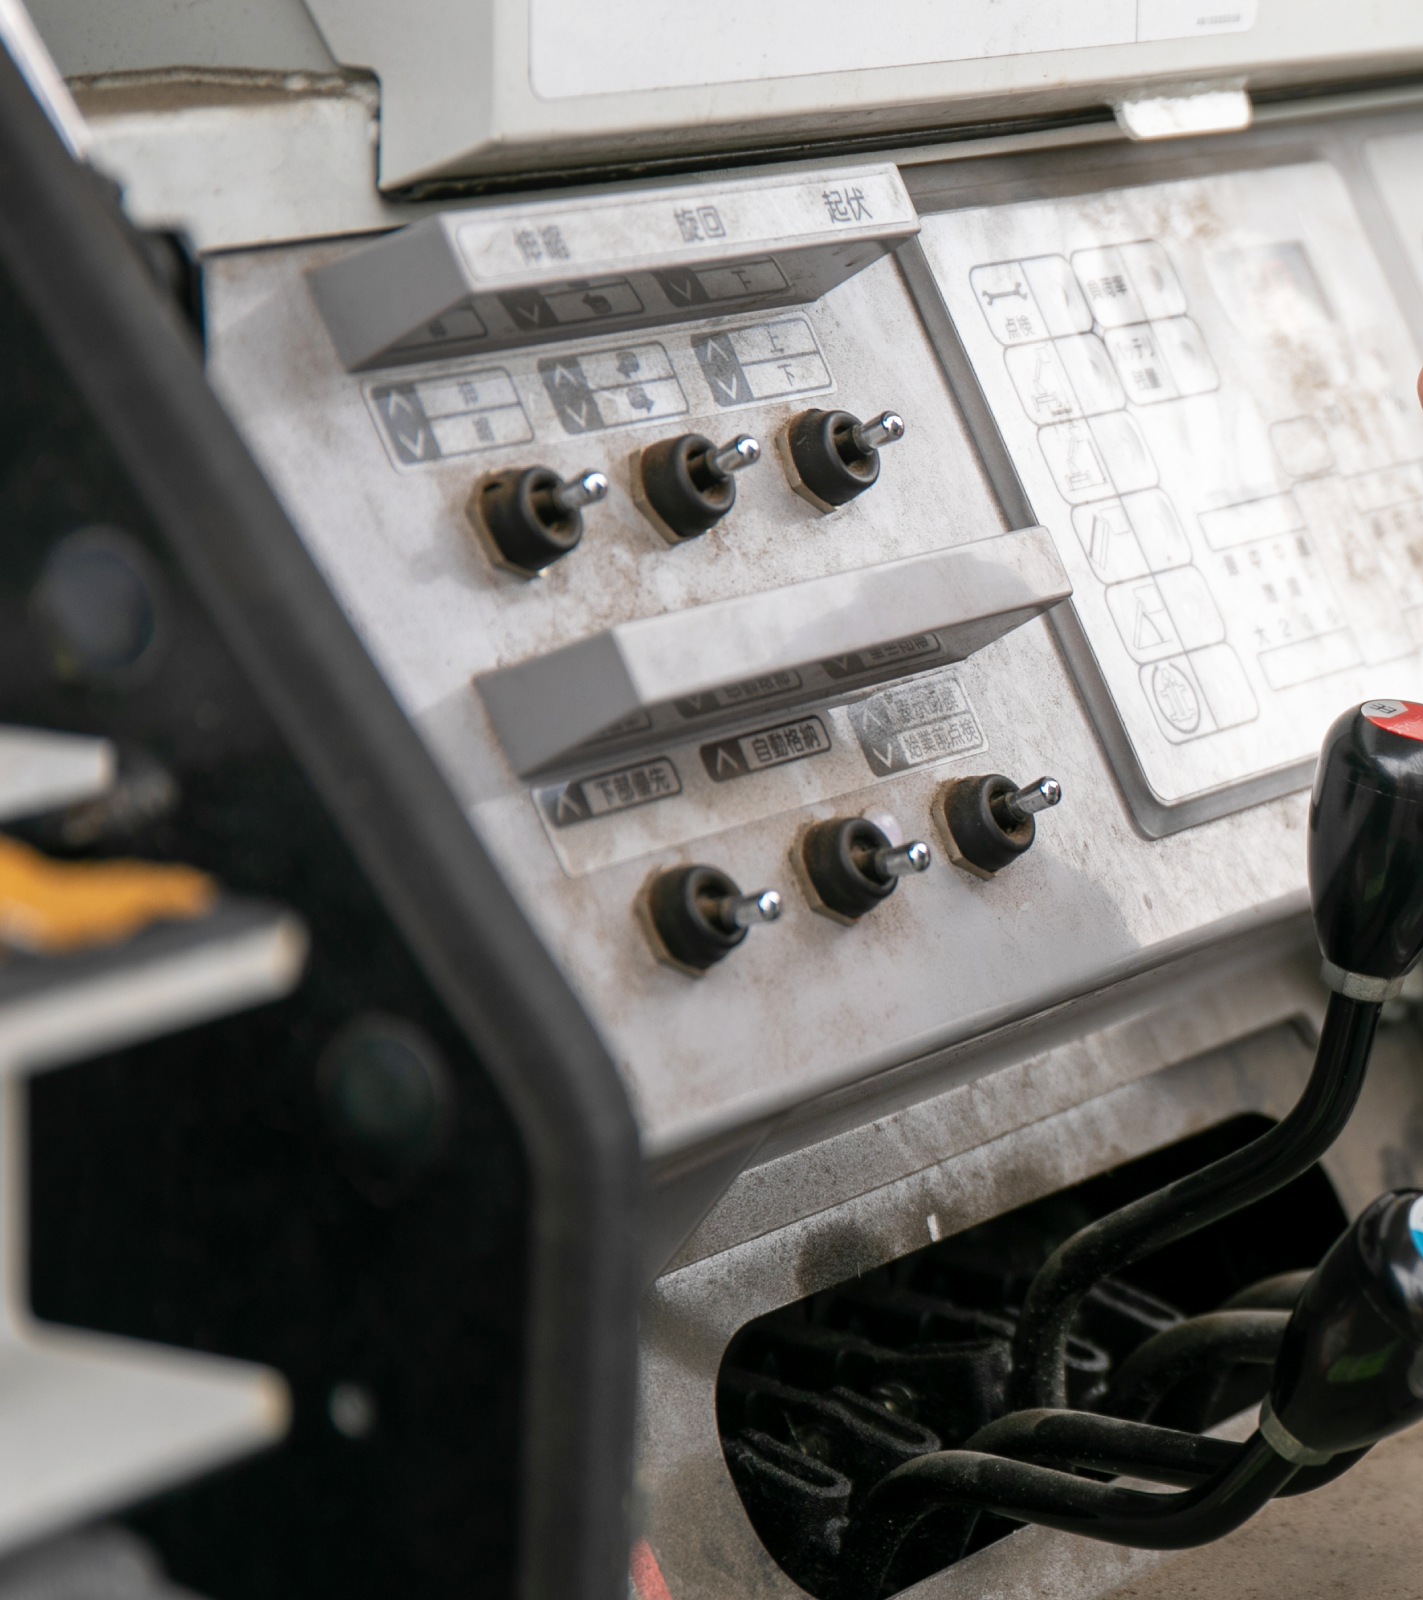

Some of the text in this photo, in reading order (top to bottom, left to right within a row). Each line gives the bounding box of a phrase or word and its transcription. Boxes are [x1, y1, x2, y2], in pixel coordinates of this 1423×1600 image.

[672, 204, 727, 243] 旋回
[822, 187, 873, 224] 起伏
[1005, 314, 1035, 339] 点検
[777, 363, 795, 387] 下
[752, 723, 821, 763] 自動格納
[595, 767, 671, 805] 下部優先
